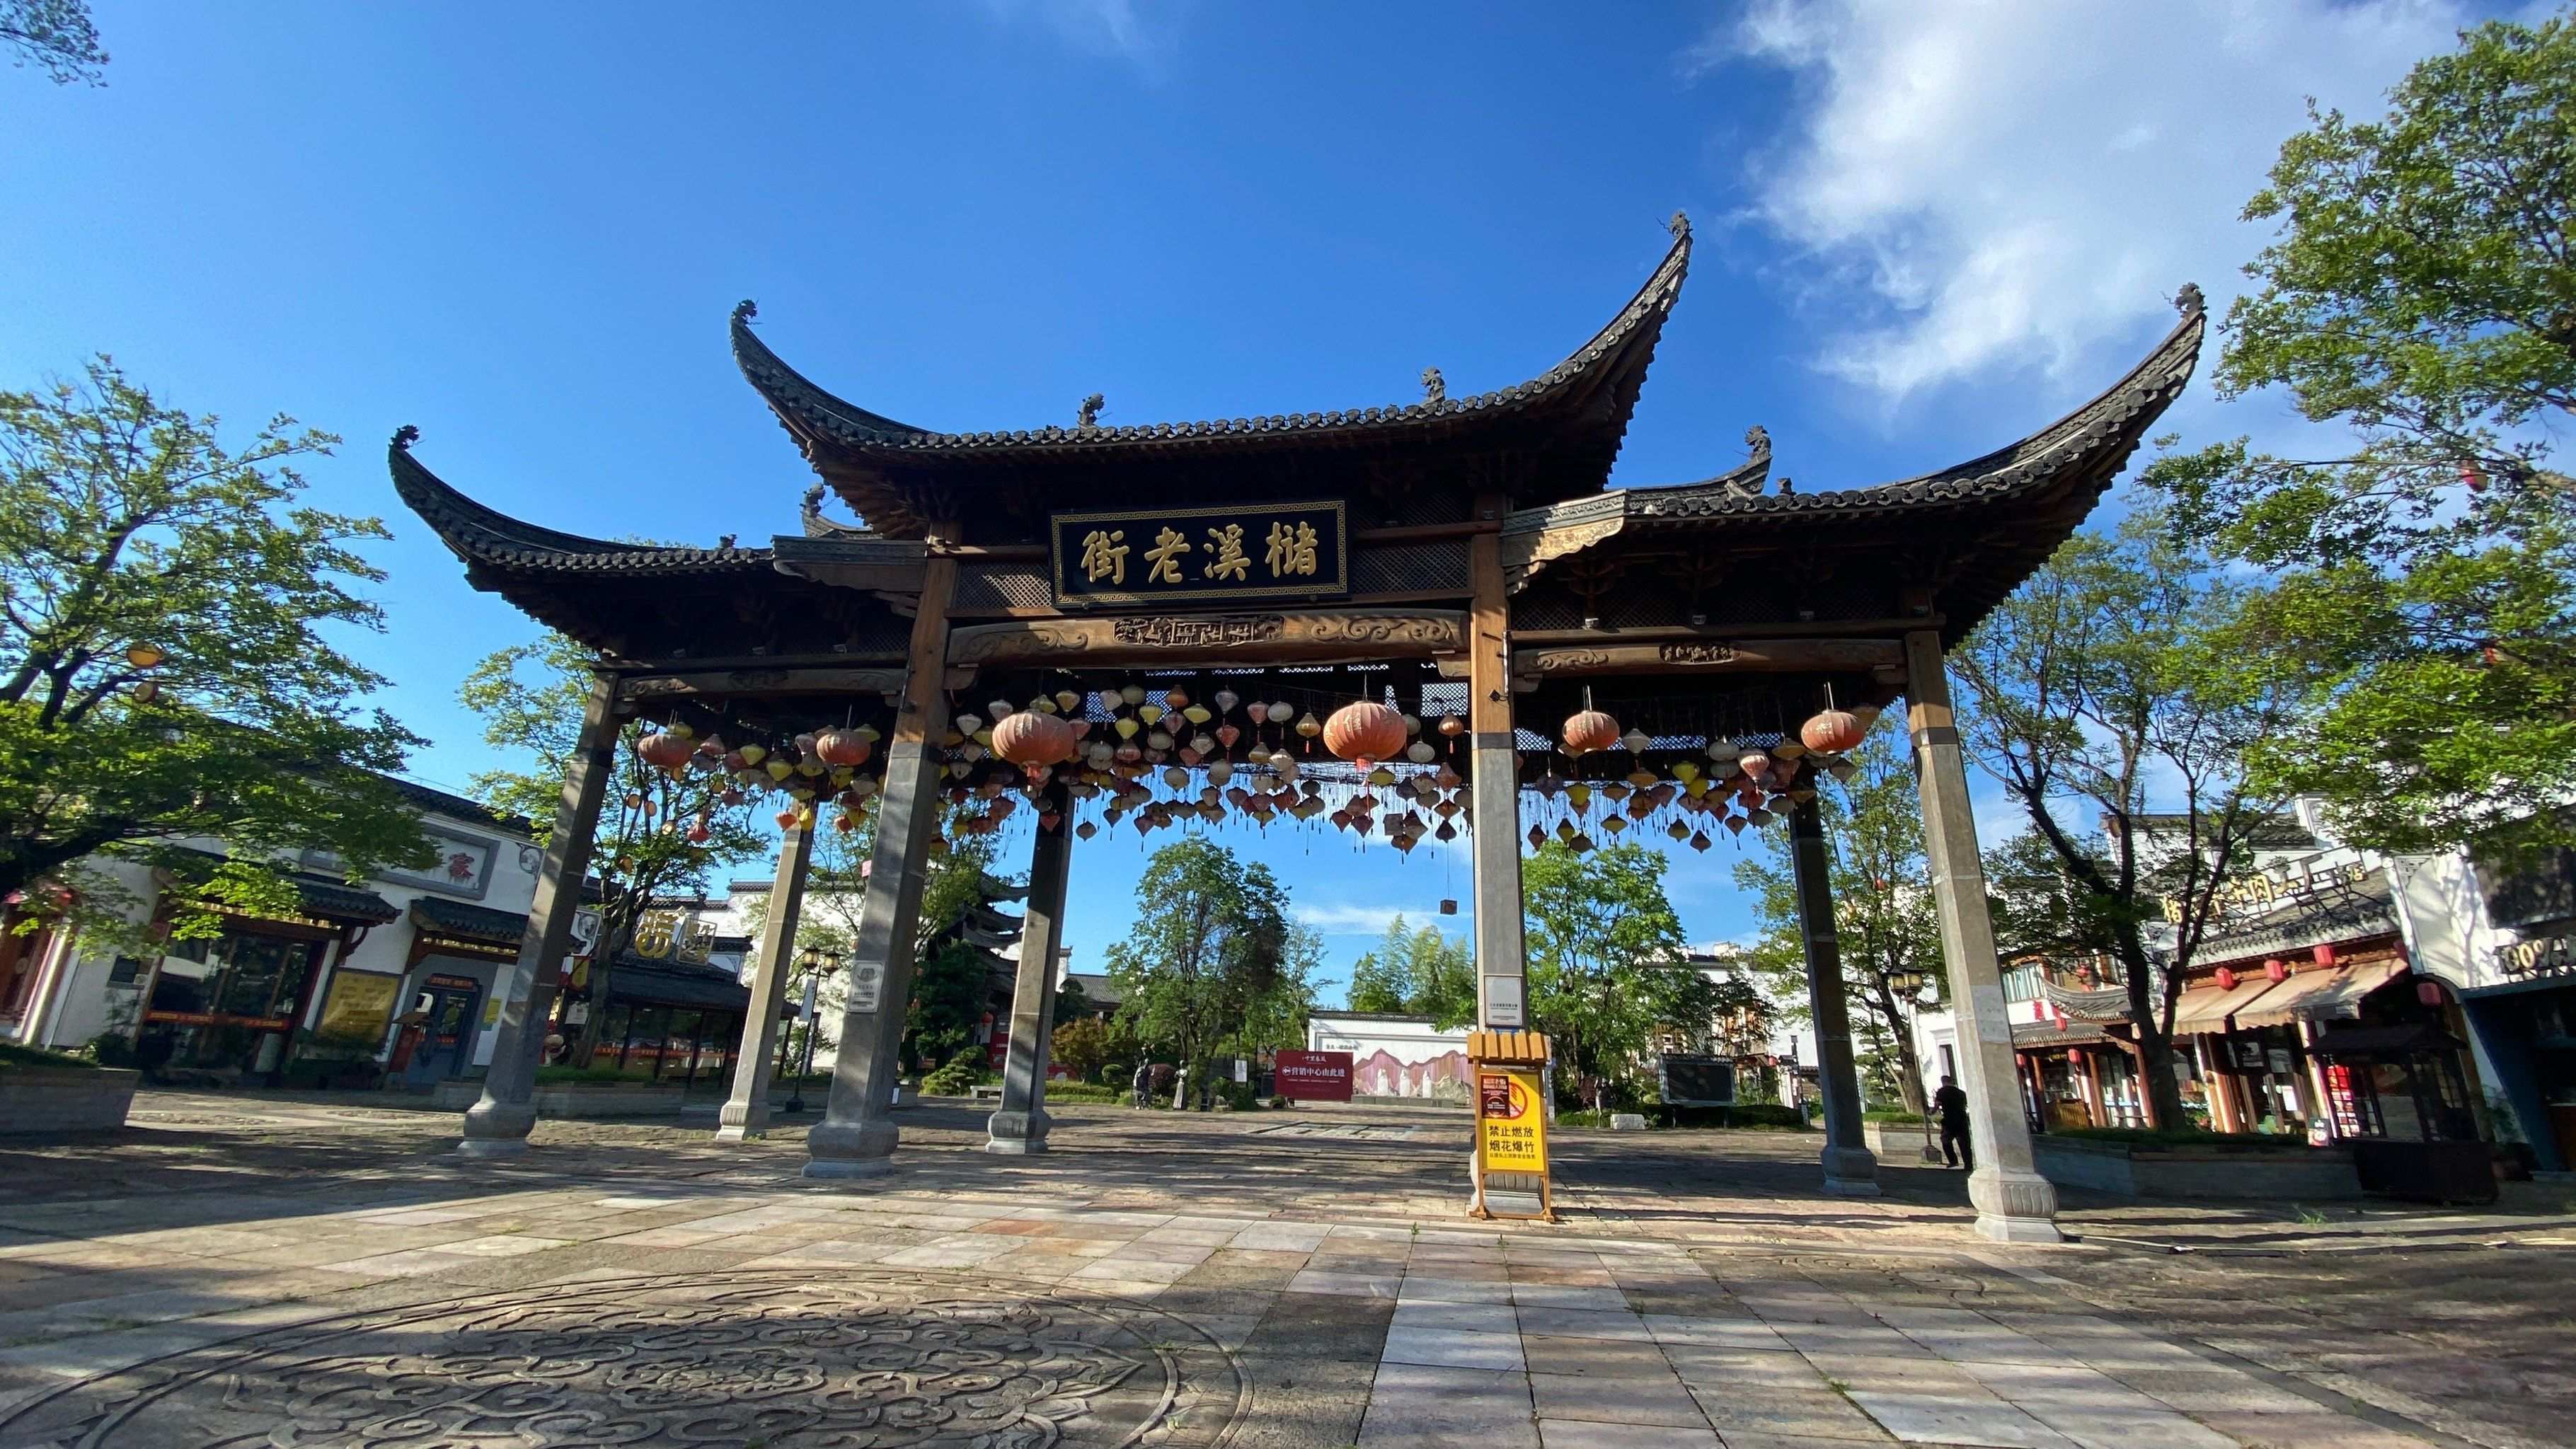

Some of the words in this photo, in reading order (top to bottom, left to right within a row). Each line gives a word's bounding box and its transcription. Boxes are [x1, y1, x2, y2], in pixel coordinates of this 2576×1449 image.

[1292, 1067, 1345, 1078] 营销中心由此进
[1488, 1126, 1534, 1138] 禁止燃放
[1489, 1140, 1535, 1153] 烟花爆竹
